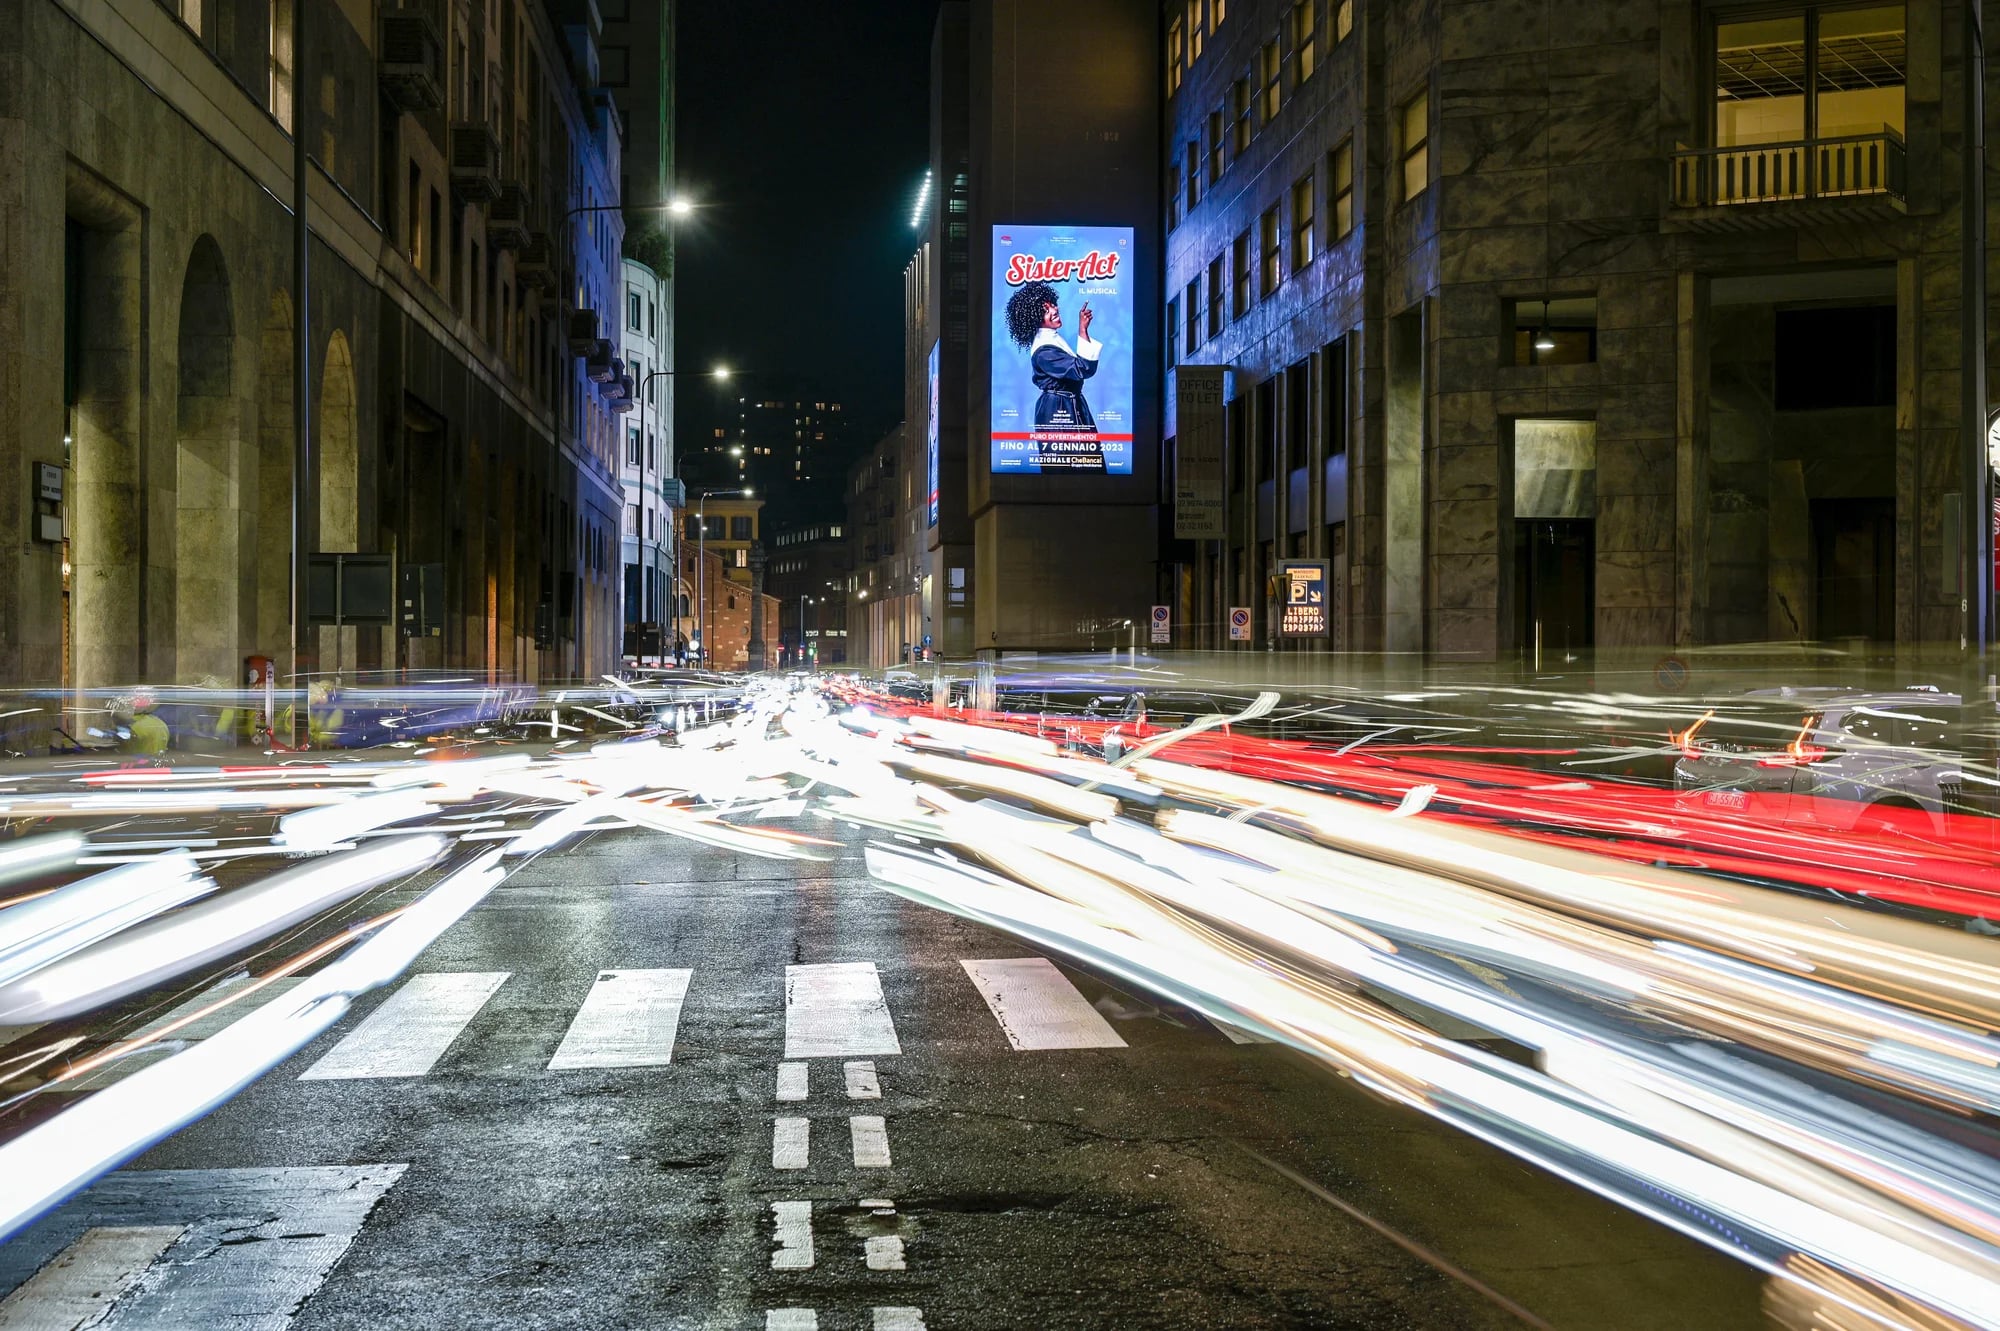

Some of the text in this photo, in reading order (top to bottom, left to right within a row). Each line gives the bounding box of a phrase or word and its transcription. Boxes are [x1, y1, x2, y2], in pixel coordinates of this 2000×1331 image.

[1006, 250, 1119, 285] Sister Act
[1179, 379, 1221, 390] OFFICE
[1180, 392, 1219, 404] TO LET
[1000, 442, 1124, 451] FINO AL 7 GENNAIO 2023
[1287, 606, 1319, 616] LIBERO
